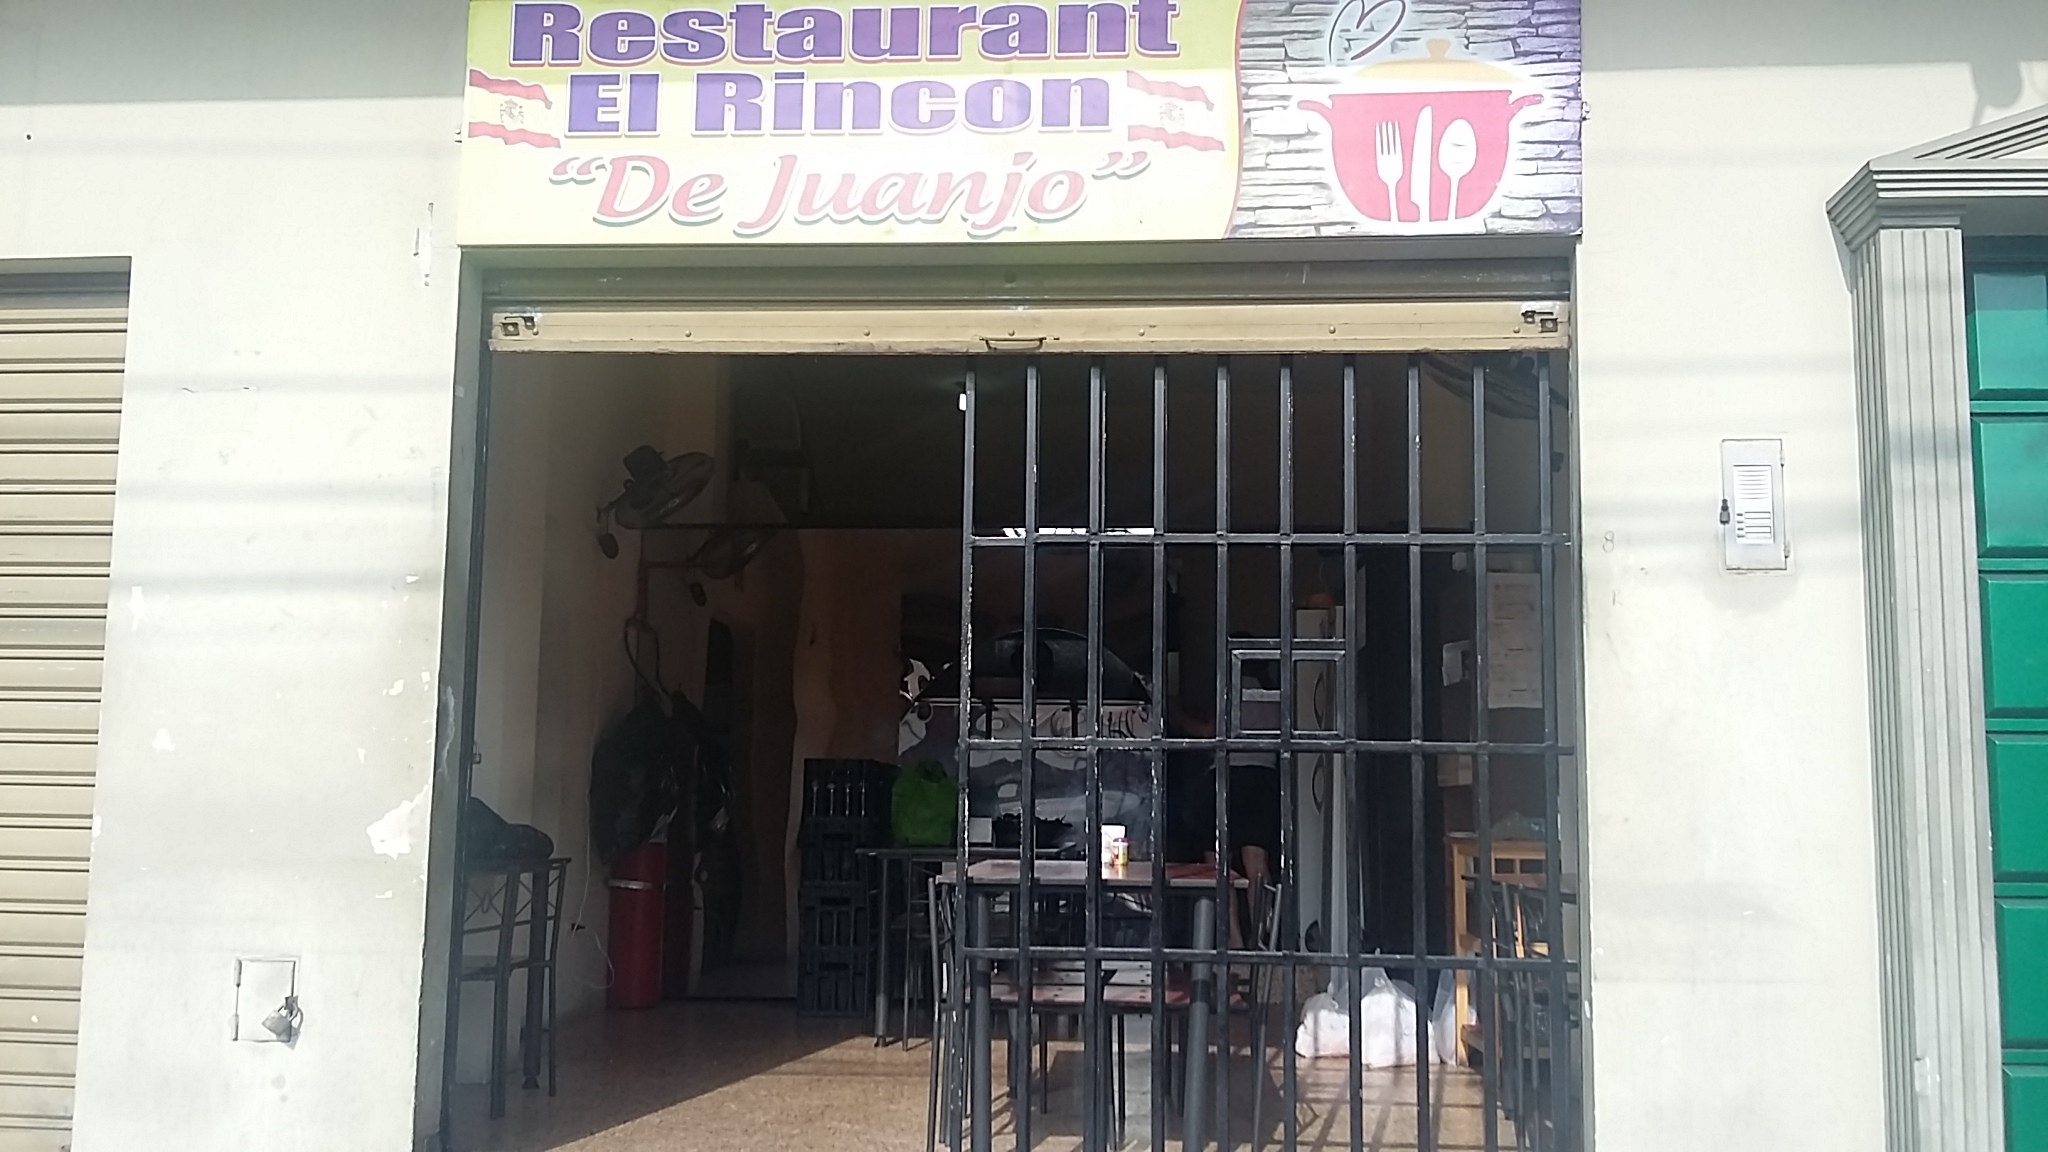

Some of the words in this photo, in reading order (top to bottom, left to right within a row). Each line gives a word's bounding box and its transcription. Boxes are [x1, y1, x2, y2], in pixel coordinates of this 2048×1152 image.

[510, 0, 1180, 65] Restaurant
[566, 73, 661, 137] El
[693, 70, 1112, 137] Rincon
